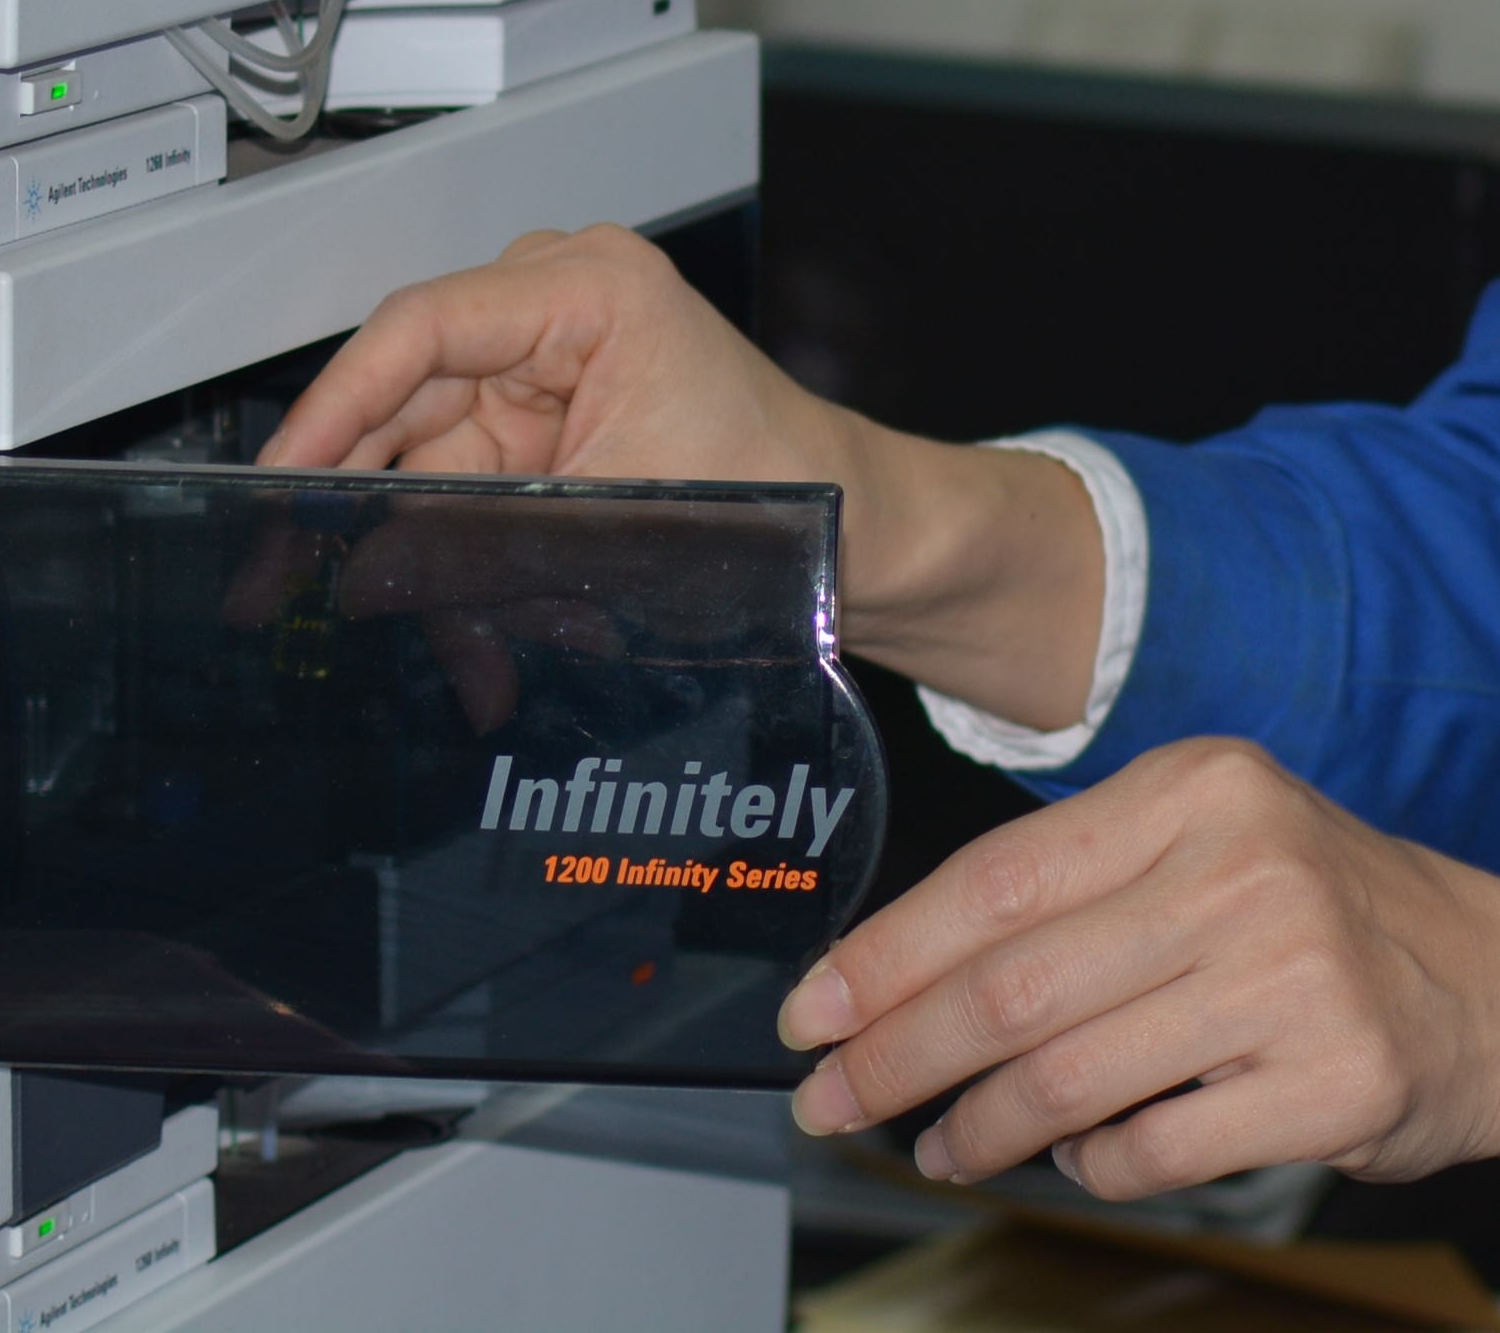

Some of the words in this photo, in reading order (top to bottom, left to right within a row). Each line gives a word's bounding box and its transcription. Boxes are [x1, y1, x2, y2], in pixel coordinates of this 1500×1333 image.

[48, 182, 77, 204] Agilent
[77, 166, 128, 193] Technologies
[479, 755, 856, 858] Infinitely
[543, 855, 610, 885] 1200
[616, 858, 720, 893] Infinity
[725, 860, 819, 892] Series
